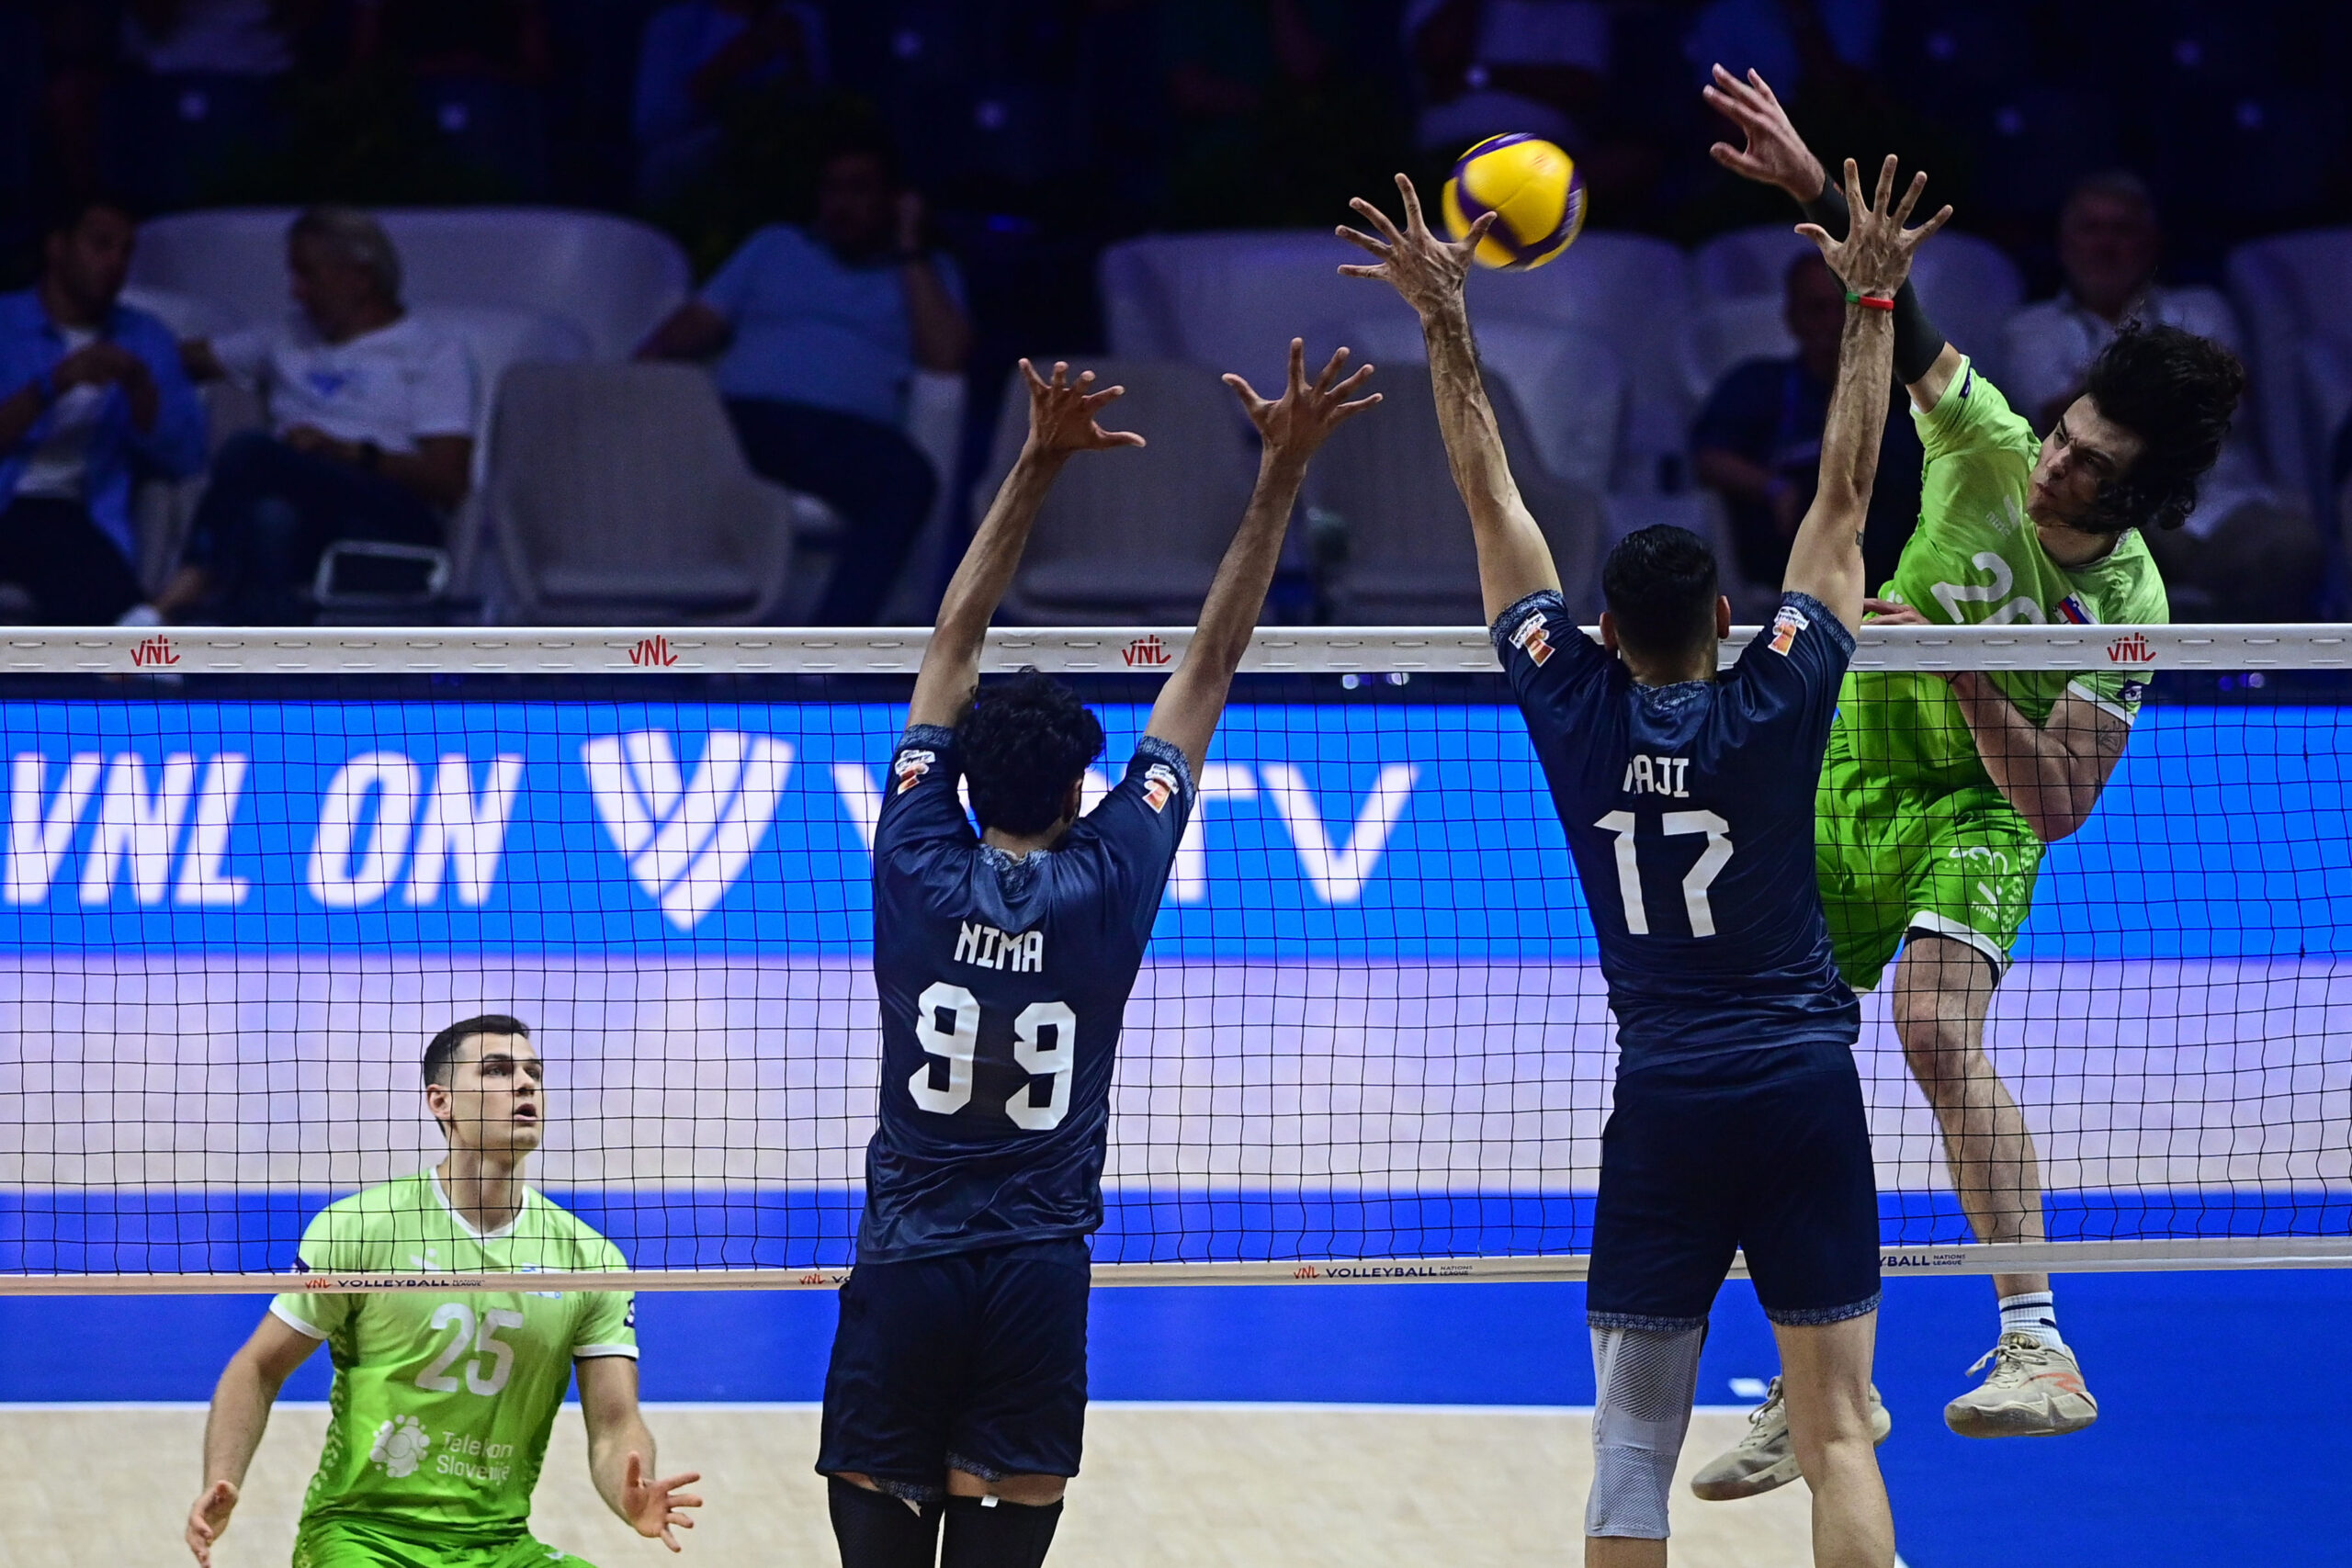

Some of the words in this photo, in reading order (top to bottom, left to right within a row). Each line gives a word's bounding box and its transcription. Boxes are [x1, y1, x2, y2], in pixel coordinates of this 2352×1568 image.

[130, 634, 180, 667] VNL
[628, 634, 678, 667] VNL
[1122, 634, 1171, 667] VNL
[2107, 632, 2156, 662] VNL
[1623, 754, 1690, 798] AJI
[3, 751, 250, 906] VNL
[308, 750, 524, 907] ON
[1593, 809, 1734, 938] 17
[954, 920, 1044, 973] NIMA
[908, 981, 1077, 1131] 99
[305, 1277, 332, 1289] VNL
[337, 1279, 449, 1288] VOLLEYBALL
[798, 1273, 825, 1285] VNL
[1294, 1265, 1320, 1279] VNL
[1326, 1267, 1437, 1279] VOLLEYBALL
[414, 1302, 525, 1396] 25
